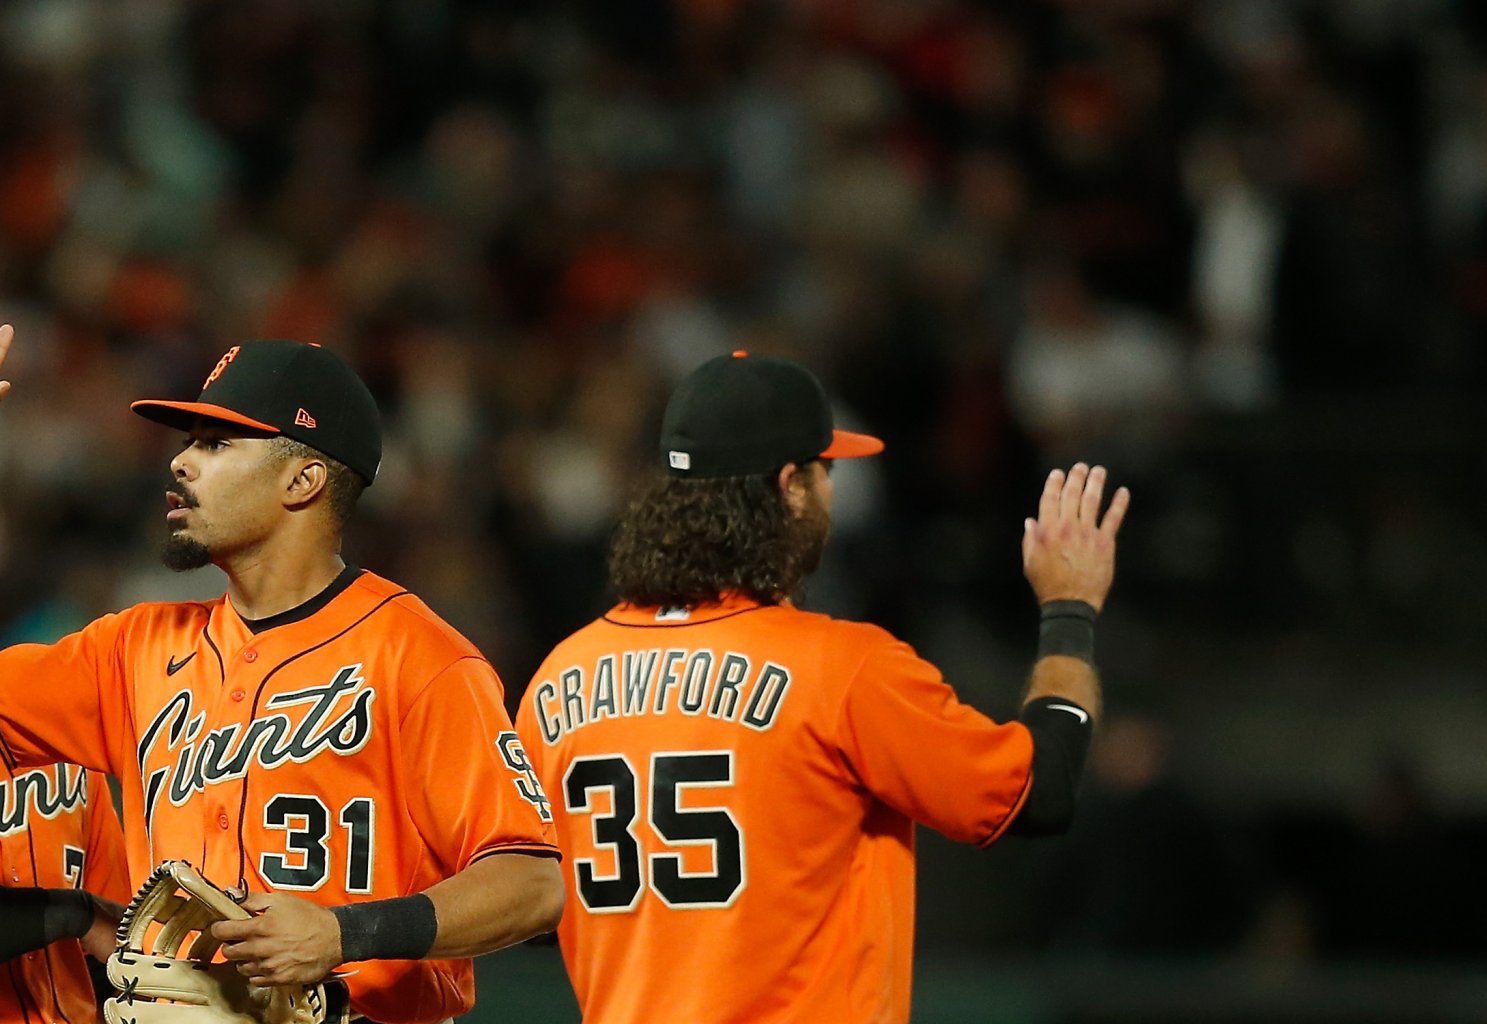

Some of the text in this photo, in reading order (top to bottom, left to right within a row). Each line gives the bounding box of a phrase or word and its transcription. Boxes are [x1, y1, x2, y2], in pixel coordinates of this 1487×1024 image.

[532, 647, 793, 747] CRAWFORD
[137, 662, 377, 868] Giants
[259, 793, 374, 895] 31
[561, 750, 748, 915] 35
